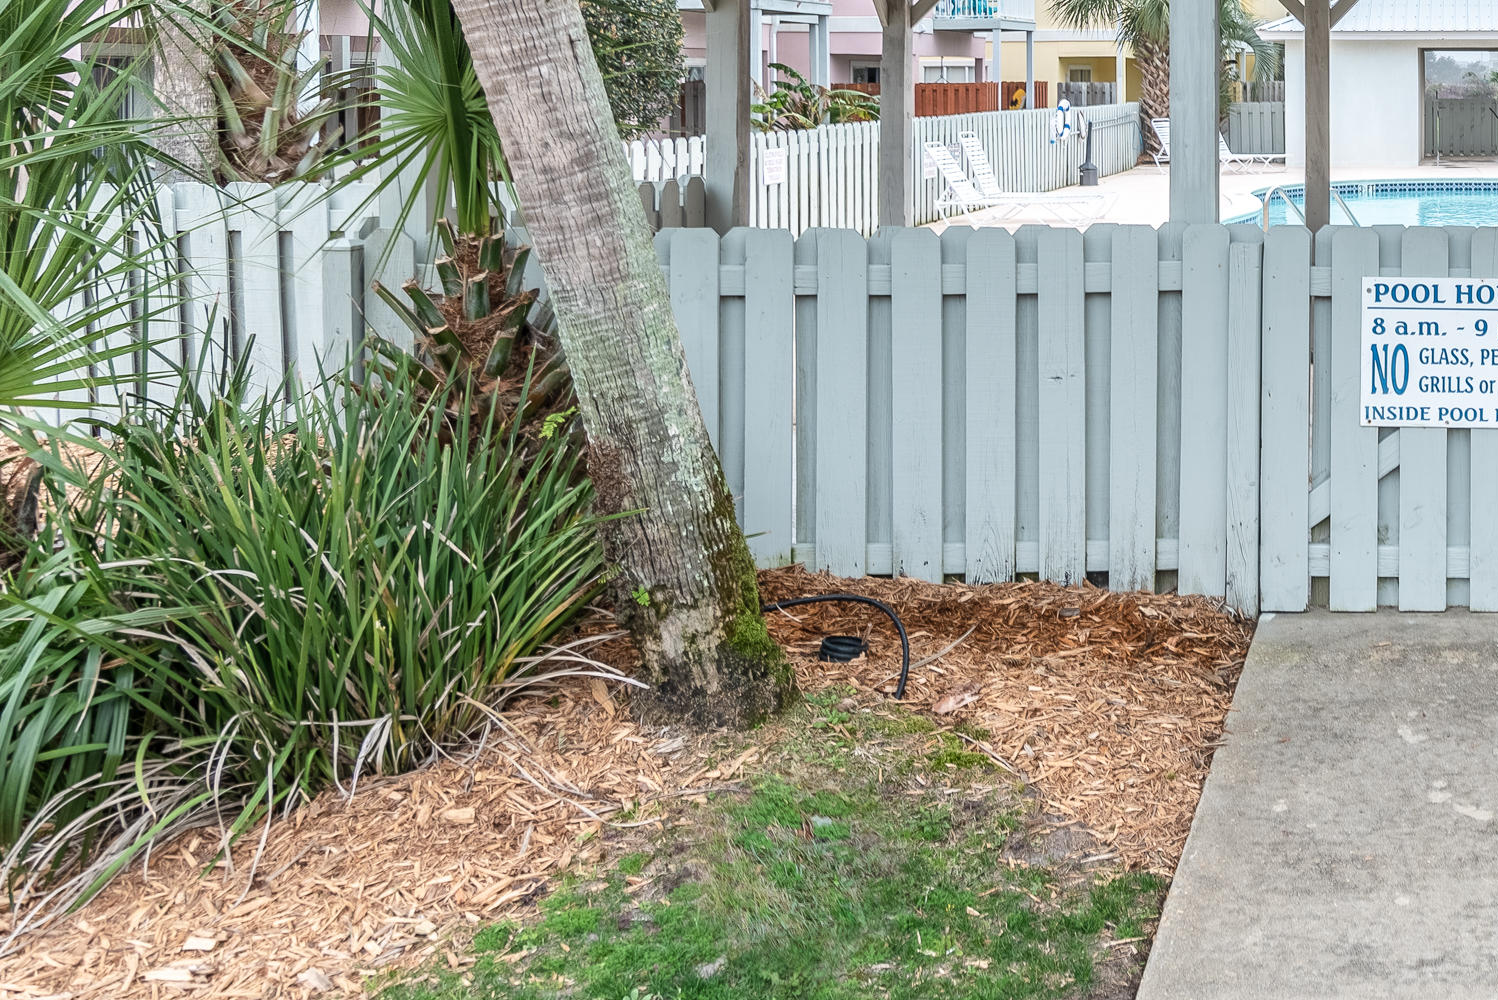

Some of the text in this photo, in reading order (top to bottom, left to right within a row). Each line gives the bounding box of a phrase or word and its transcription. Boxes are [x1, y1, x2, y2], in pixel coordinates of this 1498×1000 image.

[1374, 283, 1447, 303] POOL
[1371, 317, 1386, 335] 8
[1395, 320, 1448, 336] a.m.
[1474, 319, 1488, 336] 9
[1419, 347, 1474, 368] GLASS,
[1371, 343, 1410, 395] NO
[1418, 375, 1474, 393] GRILLS
[1479, 380, 1496, 394] or
[1365, 405, 1431, 421] INSIDE
[1438, 407, 1489, 422] POOL
